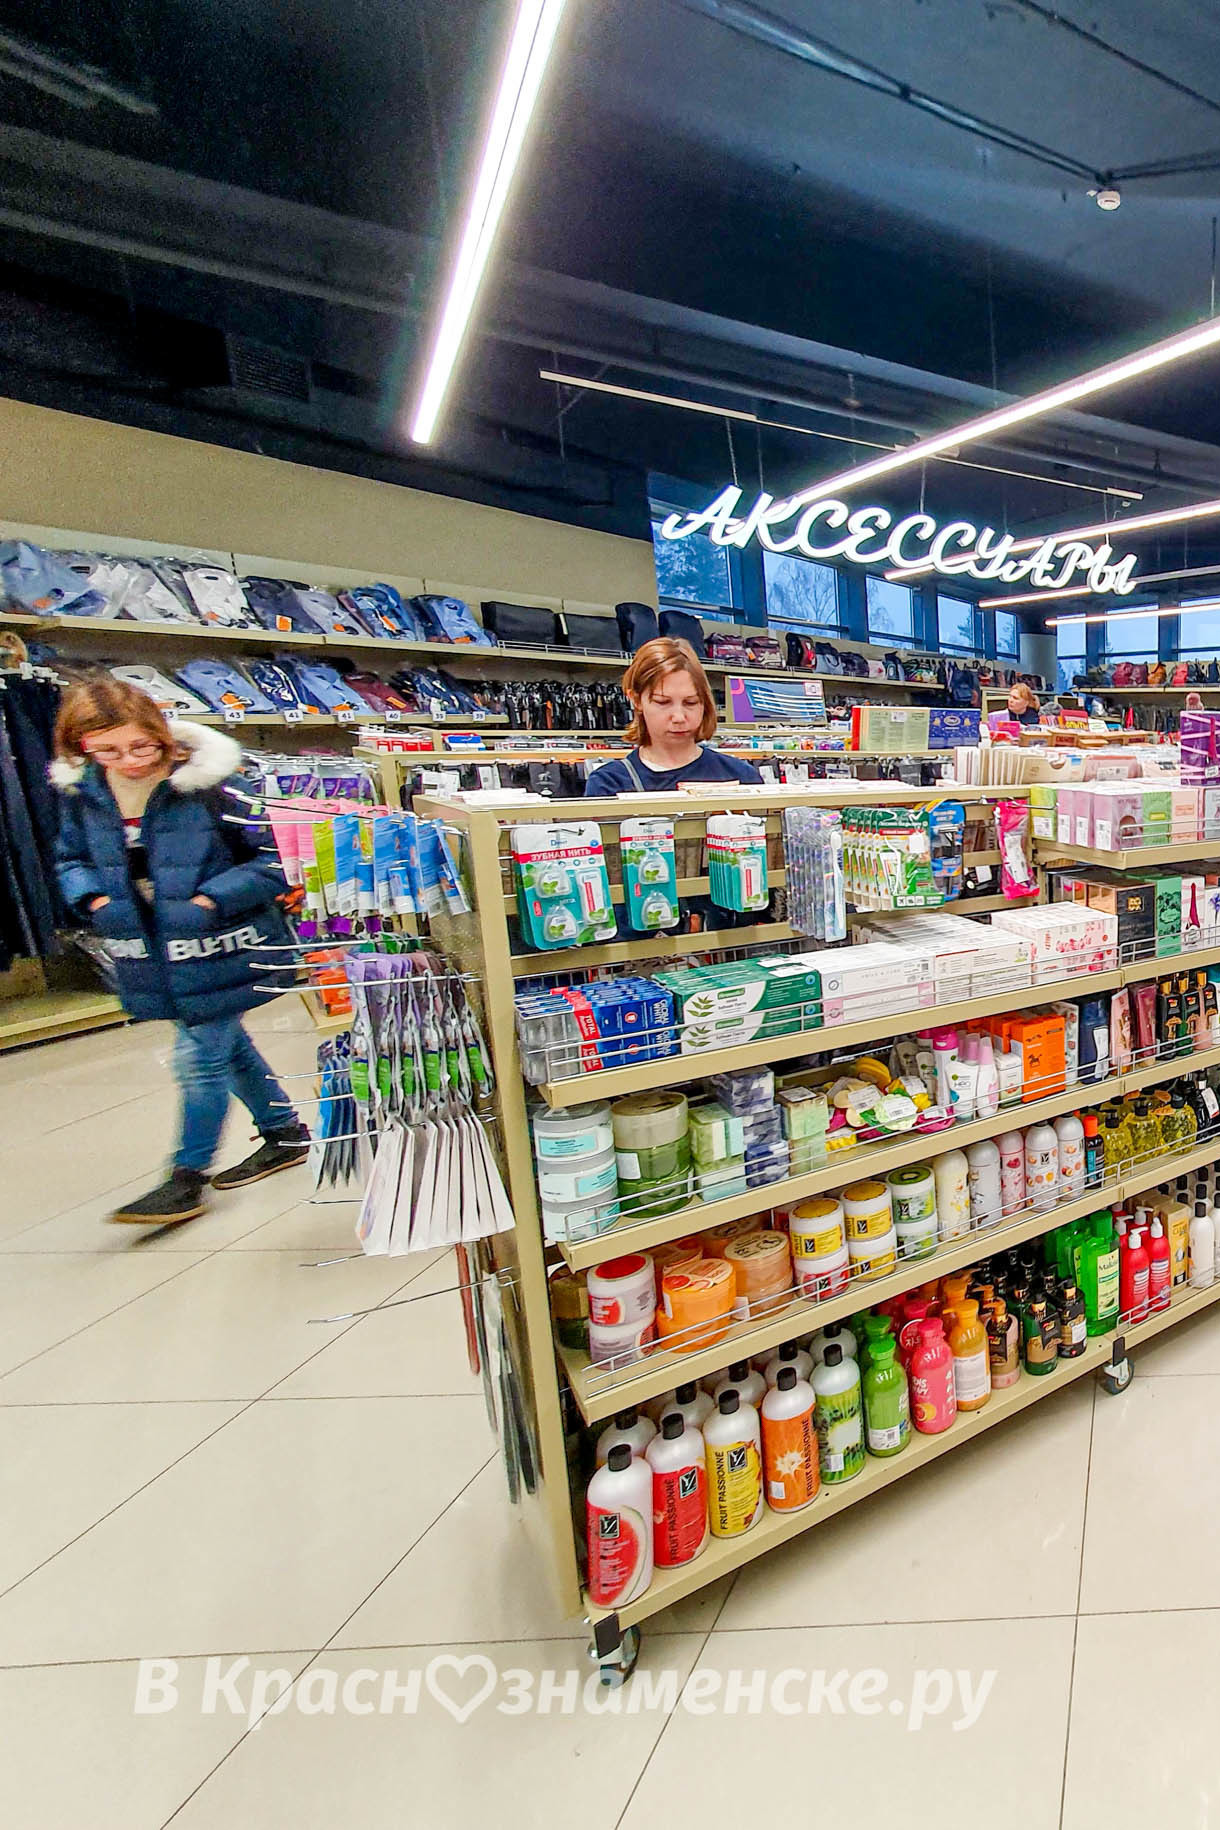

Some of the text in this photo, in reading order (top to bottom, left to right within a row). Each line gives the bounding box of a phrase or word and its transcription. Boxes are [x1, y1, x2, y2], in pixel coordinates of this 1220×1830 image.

[661, 485, 1138, 595] АКСЕССУАРЫ
[531, 847, 591, 862] ЗУБНАЯ НИТЬ
[806, 1470, 814, 1497] FRUIT
[719, 1504, 729, 1530] FRUIT
[669, 1534, 678, 1561] FRUIT
